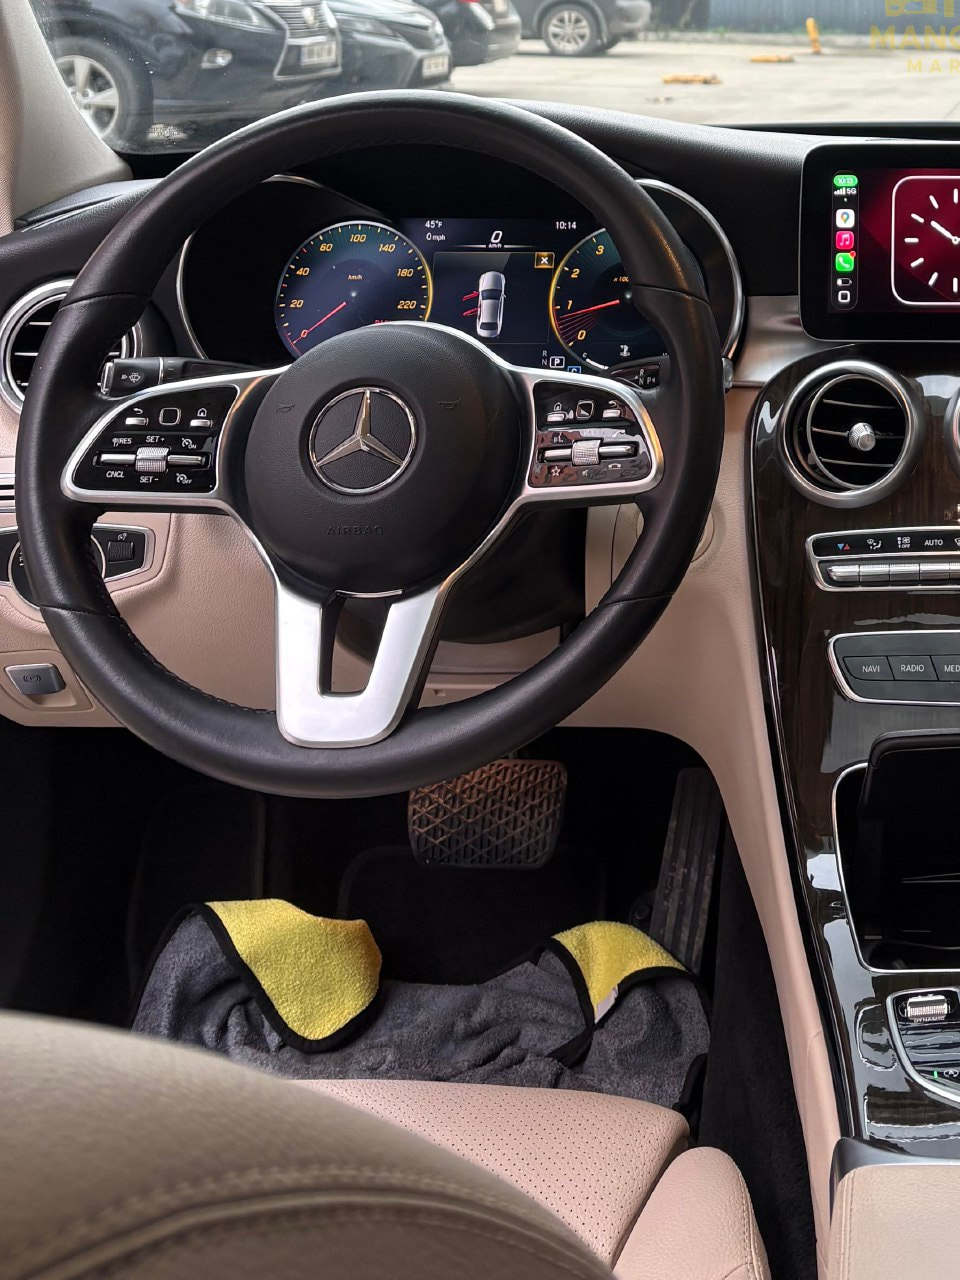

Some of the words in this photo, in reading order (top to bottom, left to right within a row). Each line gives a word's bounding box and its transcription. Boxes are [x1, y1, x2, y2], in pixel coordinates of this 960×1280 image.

[846, 187, 857, 195] 5G
[425, 220, 443, 229] 45°F
[555, 221, 577, 230] 10:14
[349, 234, 367, 243] 100
[426, 232, 432, 241] 0
[432, 233, 446, 243] mph
[490, 230, 503, 244] 0
[319, 243, 333, 252] 60
[378, 243, 396, 252] 140
[595, 245, 605, 255] 3
[296, 267, 310, 276] 40
[397, 268, 414, 277] 180
[570, 268, 580, 279] 2
[289, 299, 304, 308] 20
[397, 300, 417, 309] 220
[566, 299, 573, 310] 1
[577, 329, 587, 340] 0
[541, 358, 548, 366] N
[554, 358, 561, 366] P
[639, 368, 645, 376] R
[638, 377, 644, 386] N
[646, 376, 652, 385] P
[119, 437, 132, 445] RES
[106, 470, 125, 478] CNCL
[326, 525, 384, 536] AIRBAG
[862, 665, 881, 673] NAVI
[900, 664, 925, 672] RADIO
